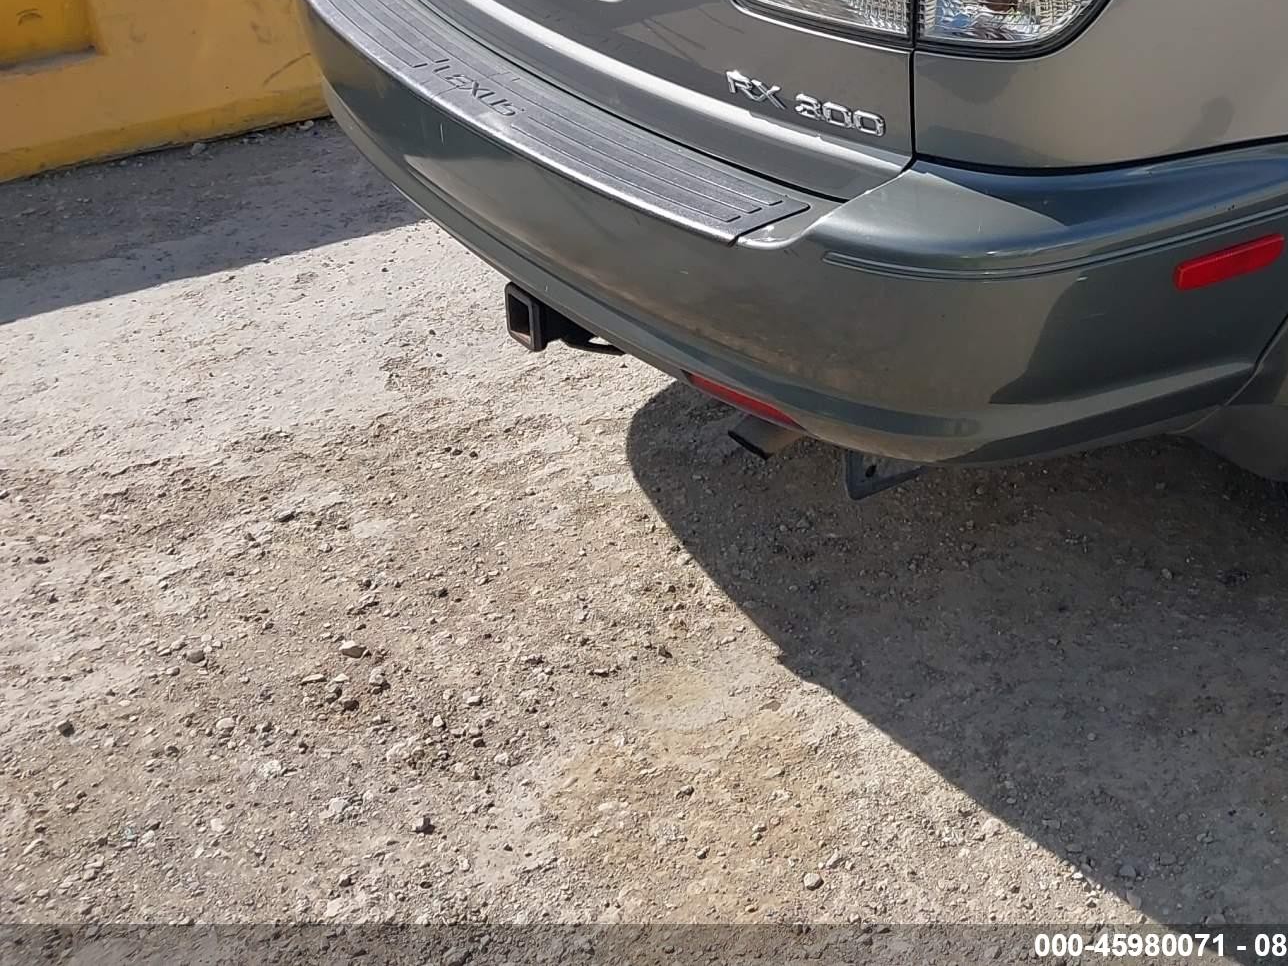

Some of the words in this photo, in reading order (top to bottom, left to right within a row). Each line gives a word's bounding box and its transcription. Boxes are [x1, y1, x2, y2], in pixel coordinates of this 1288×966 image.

[433, 64, 516, 116] LEXUS
[726, 69, 787, 111] RX
[795, 93, 886, 138] 300
